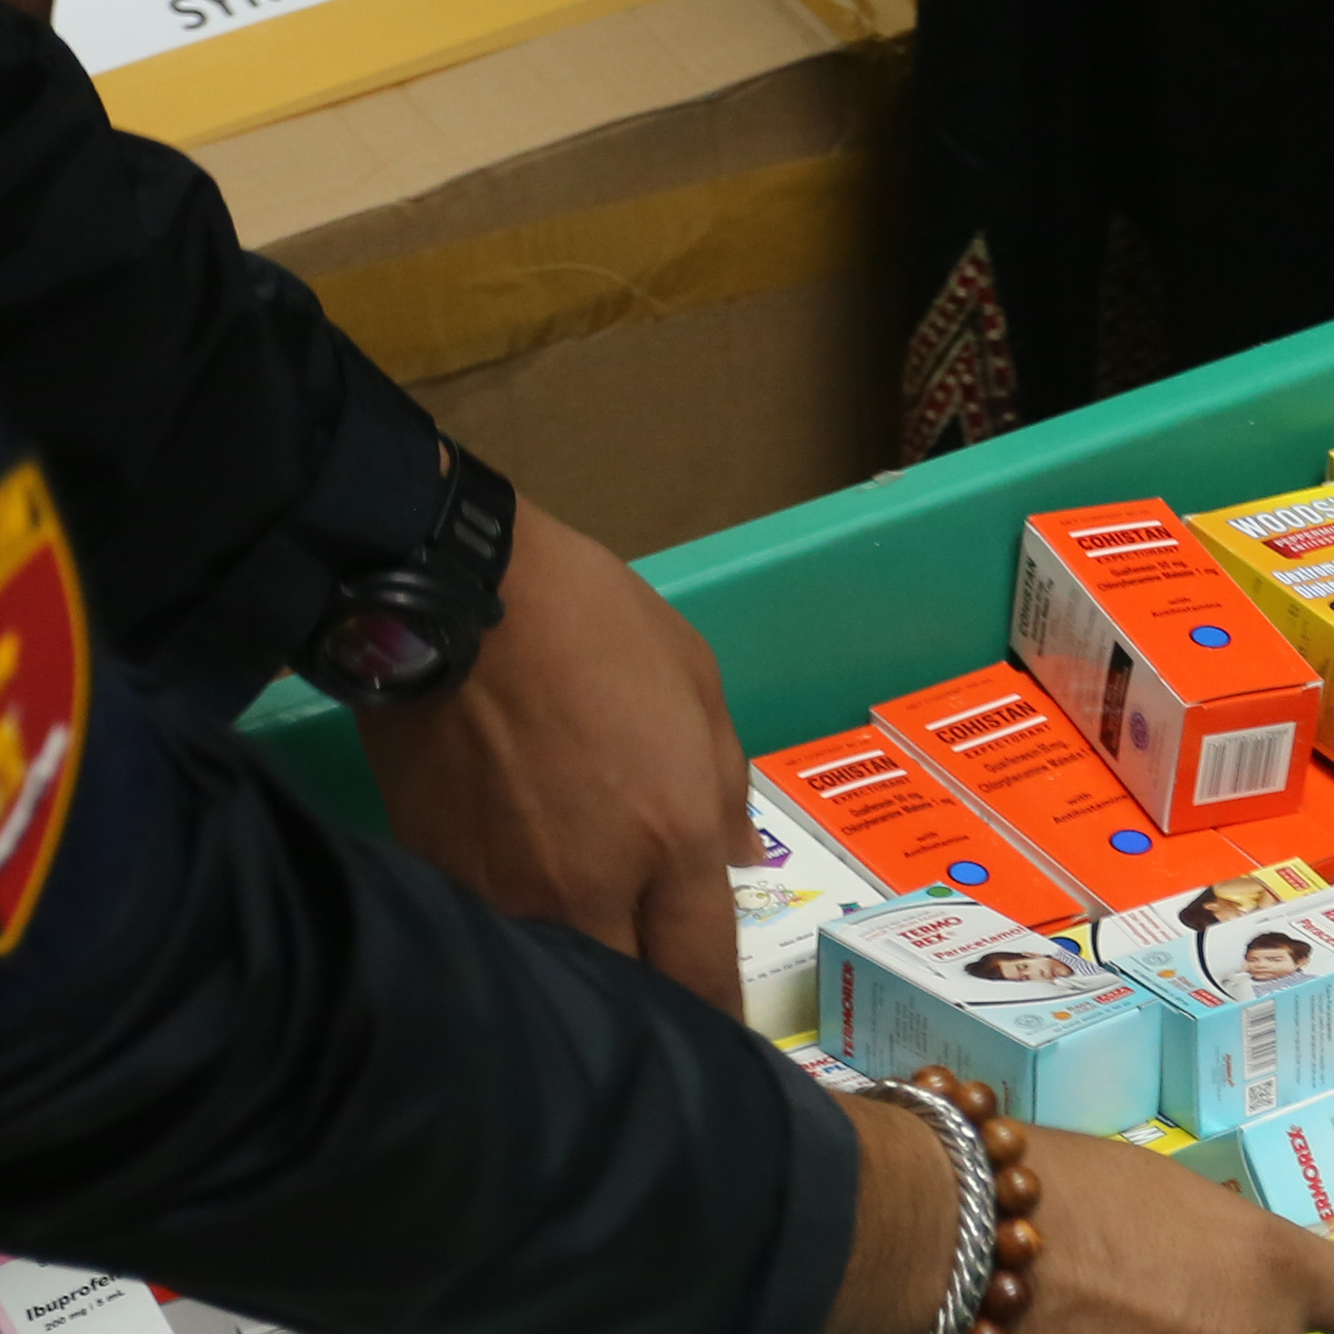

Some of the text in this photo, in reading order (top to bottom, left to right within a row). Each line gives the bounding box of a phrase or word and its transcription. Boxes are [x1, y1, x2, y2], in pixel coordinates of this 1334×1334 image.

[1077, 526, 1173, 551] COHISTAN
[1096, 546, 1181, 565] EXPECTORANT
[1168, 597, 1191, 606] with
[935, 701, 1038, 745] COHISTAN
[963, 724, 1053, 760] EXPECTORANT
[808, 757, 899, 792] COHISTAN
[832, 778, 911, 805] EXPECTORANT
[1066, 792, 1093, 807] with
[916, 831, 939, 843] with
[896, 916, 964, 940] TERMO
[911, 933, 950, 950] REX
[933, 925, 1027, 961] Paracetamol
[840, 960, 855, 1059] TERMOREX
[44, 1316, 67, 1332] 200
[68, 1308, 88, 1321] mg
